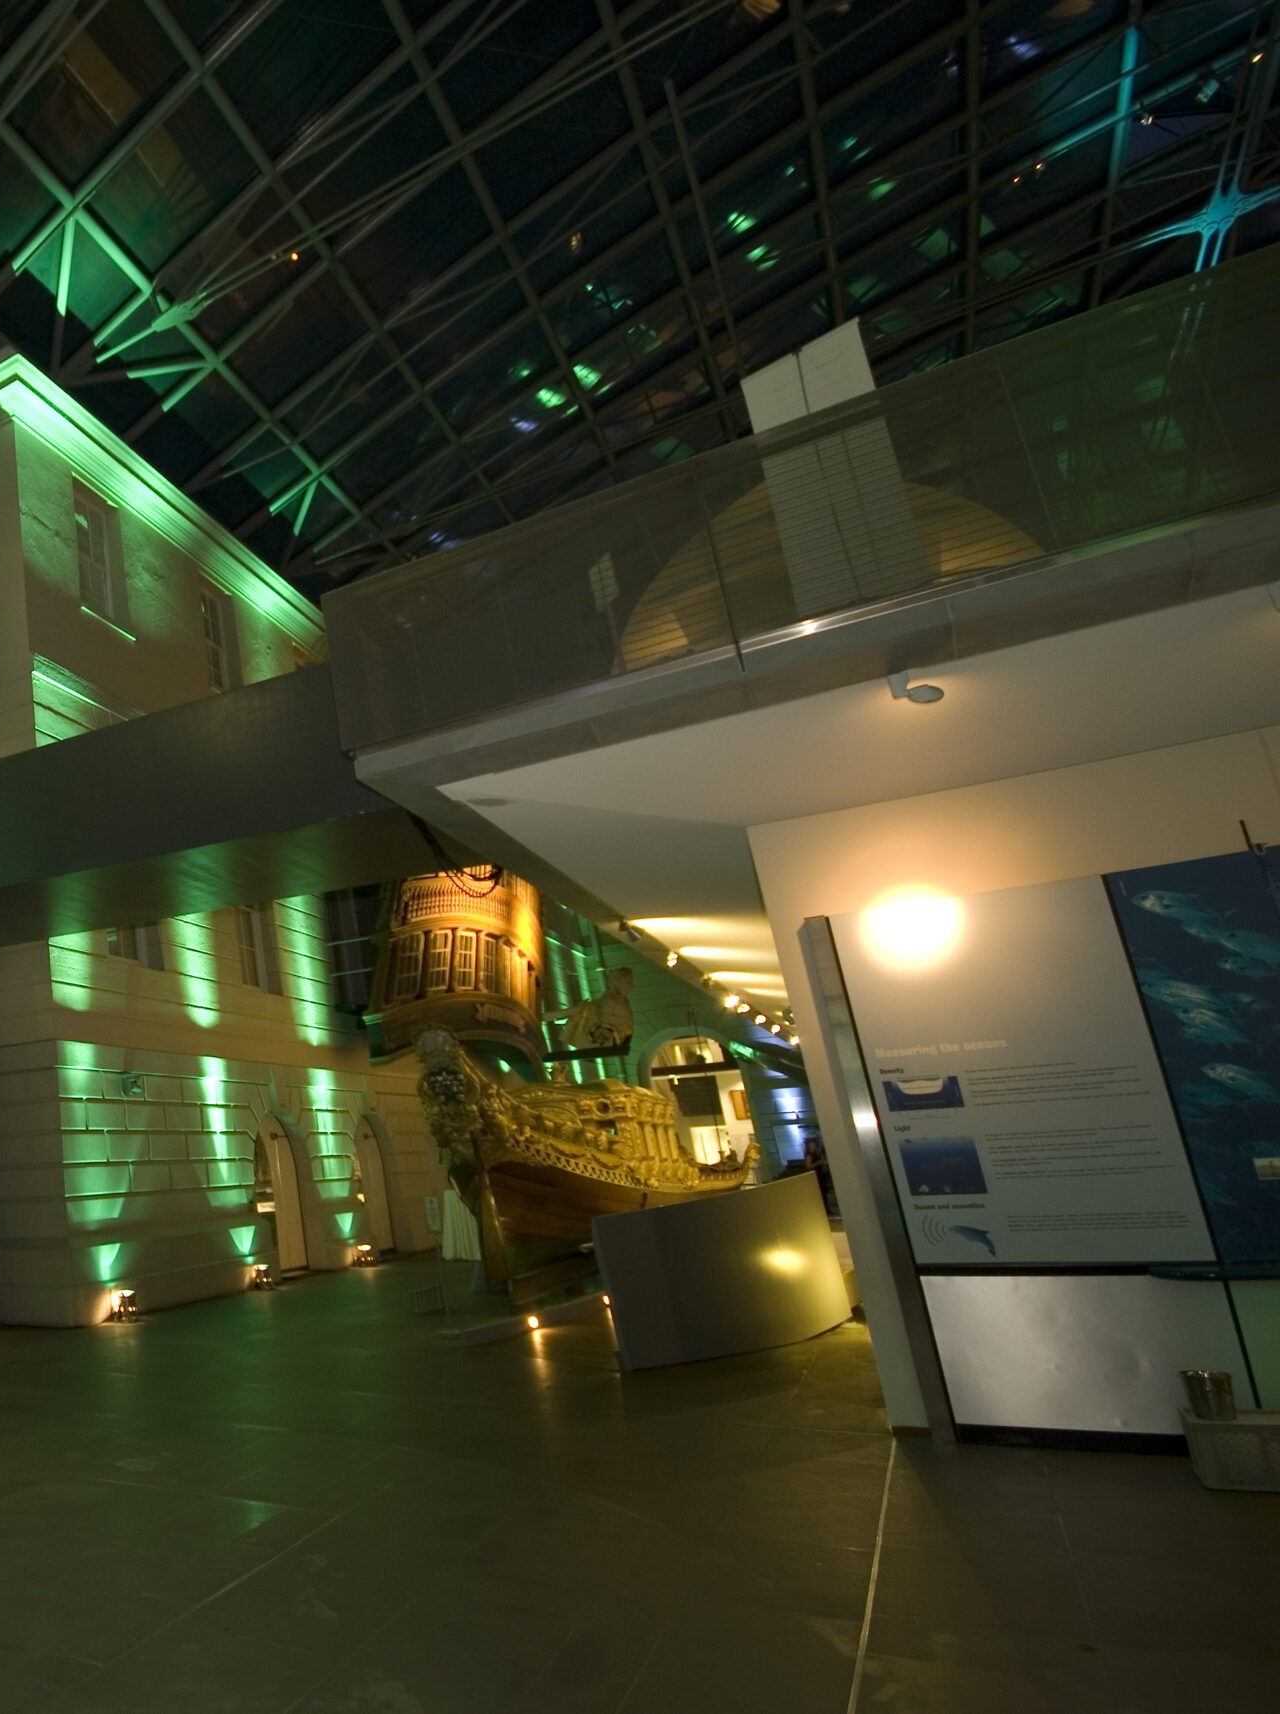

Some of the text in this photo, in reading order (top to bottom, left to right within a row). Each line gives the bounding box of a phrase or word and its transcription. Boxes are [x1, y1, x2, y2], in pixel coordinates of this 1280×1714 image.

[874, 1039, 1008, 1058] Measuring the oceans
